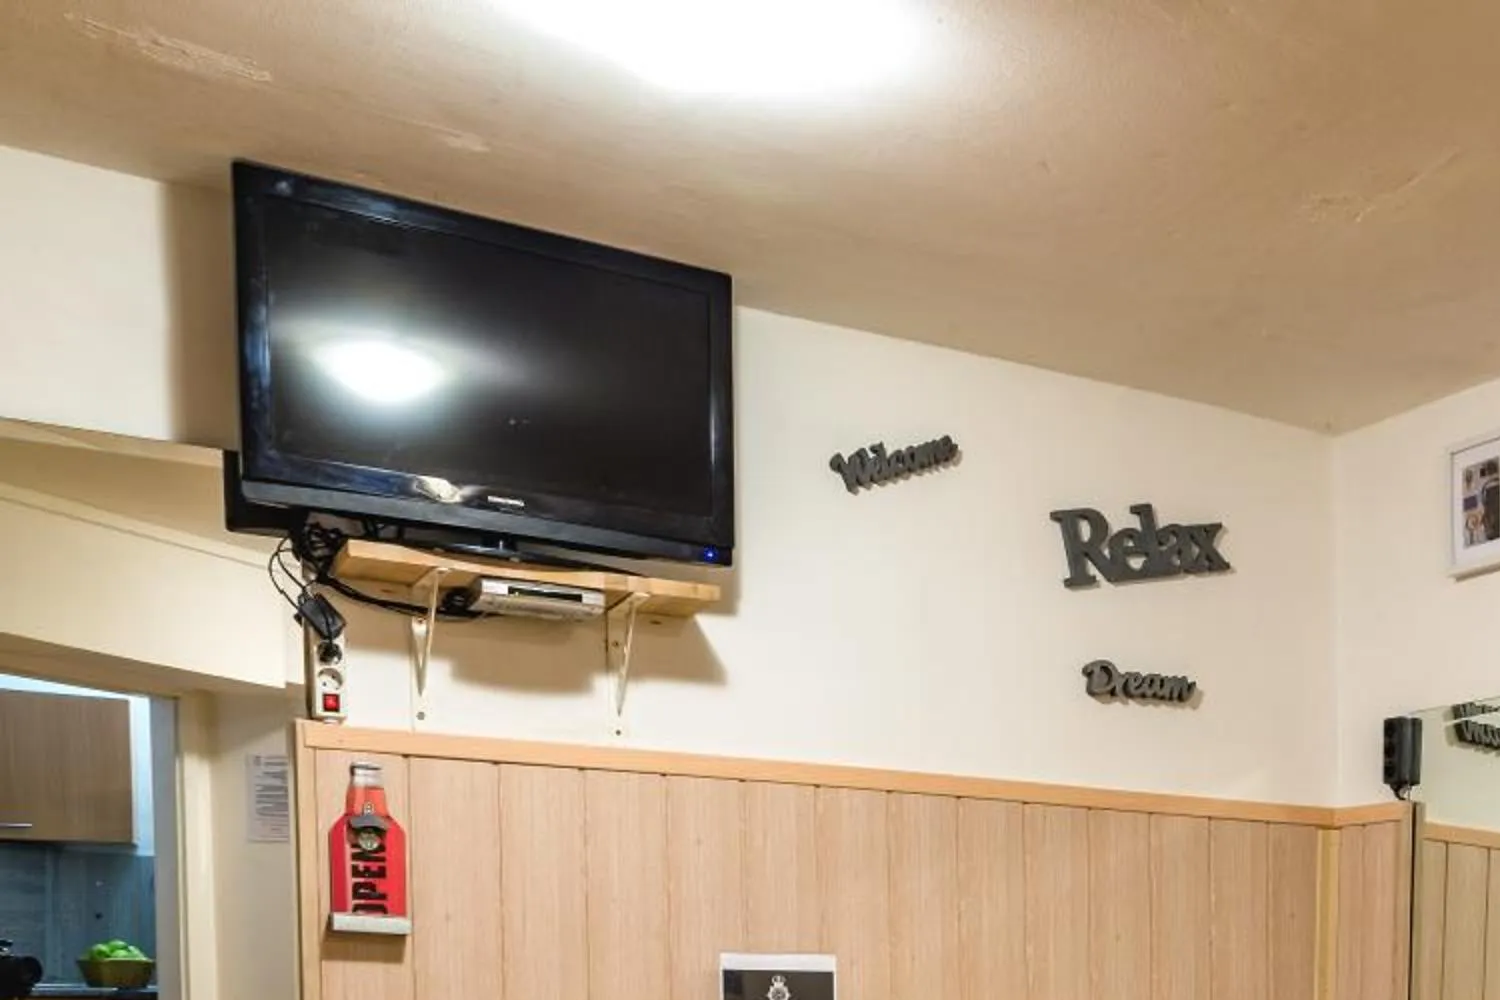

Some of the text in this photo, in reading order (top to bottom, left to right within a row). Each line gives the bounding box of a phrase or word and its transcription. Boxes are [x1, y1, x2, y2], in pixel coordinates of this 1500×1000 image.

[829, 435, 959, 494] Welcome
[1049, 503, 1231, 588] Relax
[1081, 659, 1197, 702] Dream
